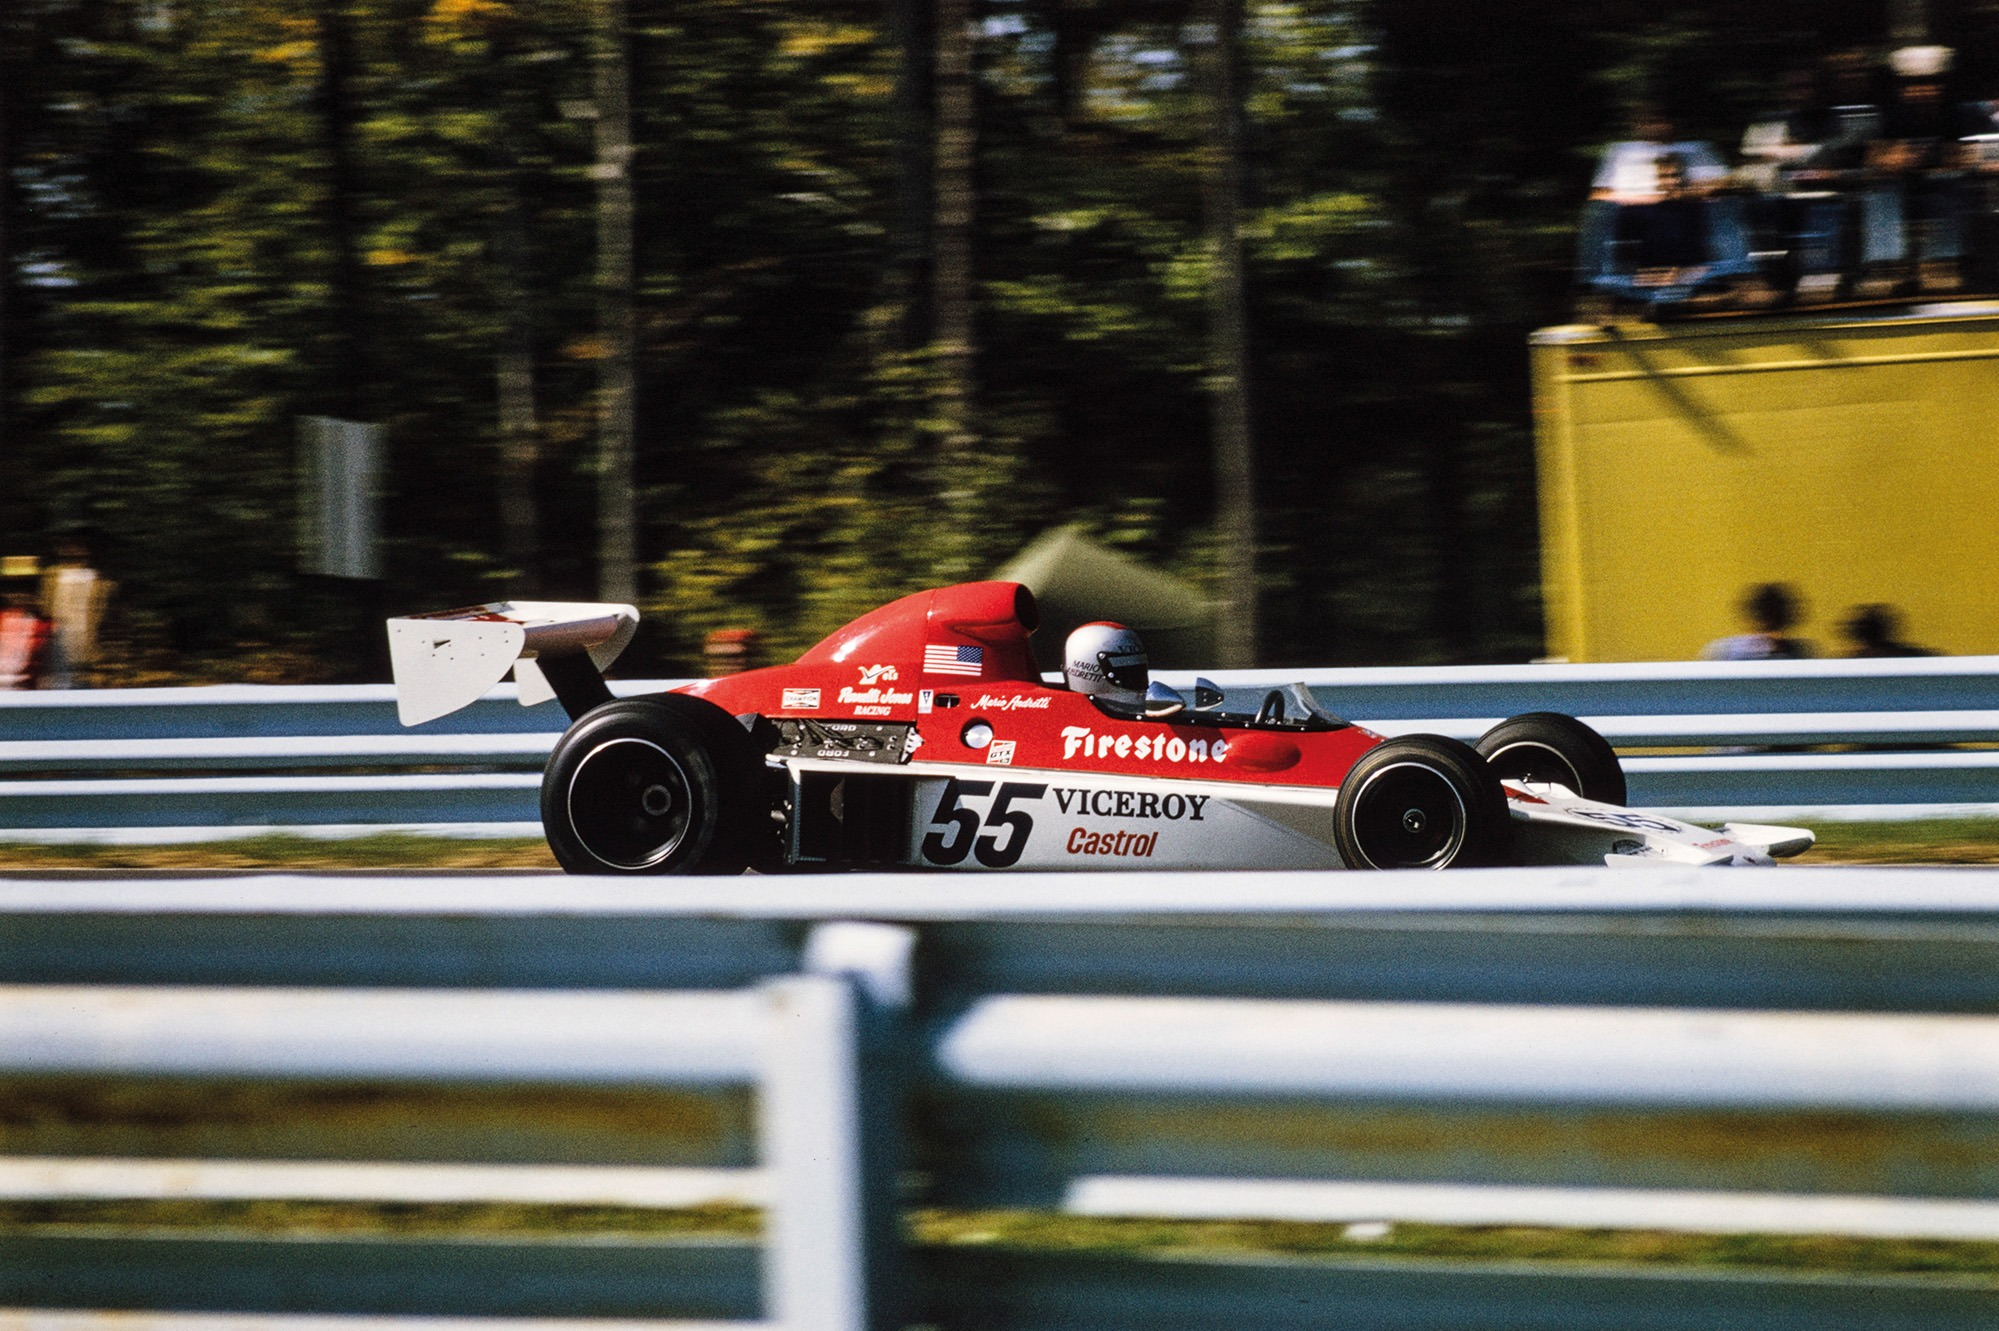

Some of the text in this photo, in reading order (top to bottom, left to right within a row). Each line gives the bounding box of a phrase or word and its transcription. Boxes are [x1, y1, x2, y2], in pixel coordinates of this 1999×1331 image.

[1073, 660, 1100, 673] MARIO
[853, 705, 892, 716] RACING
[970, 694, 1052, 711] Mario Andretti
[825, 723, 857, 732] ORD
[1060, 725, 1231, 763] Firestone
[989, 749, 1012, 759] GTX
[1052, 787, 1211, 821] VICEROY
[921, 778, 1049, 868] 55
[1066, 827, 1159, 857] Castrol
